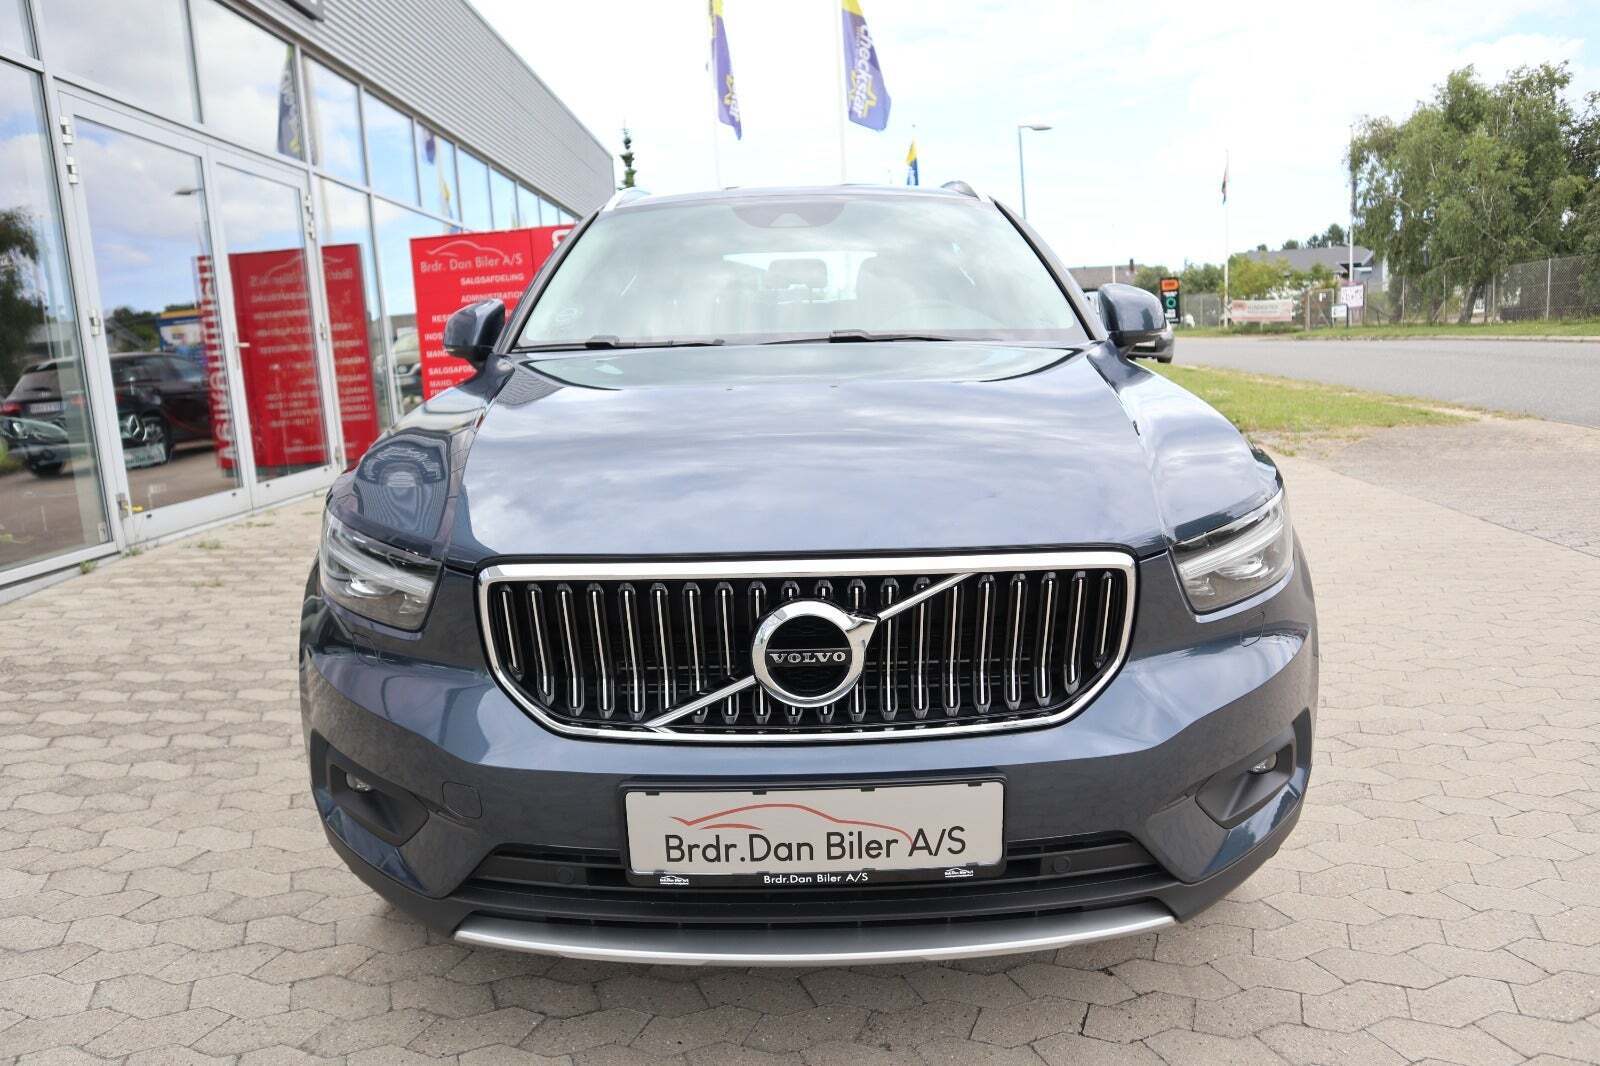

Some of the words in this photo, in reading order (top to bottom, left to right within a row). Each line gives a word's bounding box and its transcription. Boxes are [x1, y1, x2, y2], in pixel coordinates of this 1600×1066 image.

[852, 23, 875, 119] checkstar
[420, 260, 447, 273] Brdr.
[449, 258, 472, 270] Dan
[475, 255, 499, 268] Biler
[502, 252, 523, 265] A/S
[460, 273, 524, 286] SALGSAFDELING
[769, 651, 846, 664] VOLVO
[826, 830, 899, 860] Biler
[908, 825, 966, 857] A/S
[816, 873, 842, 883] Biler
[845, 872, 869, 882] A/S
